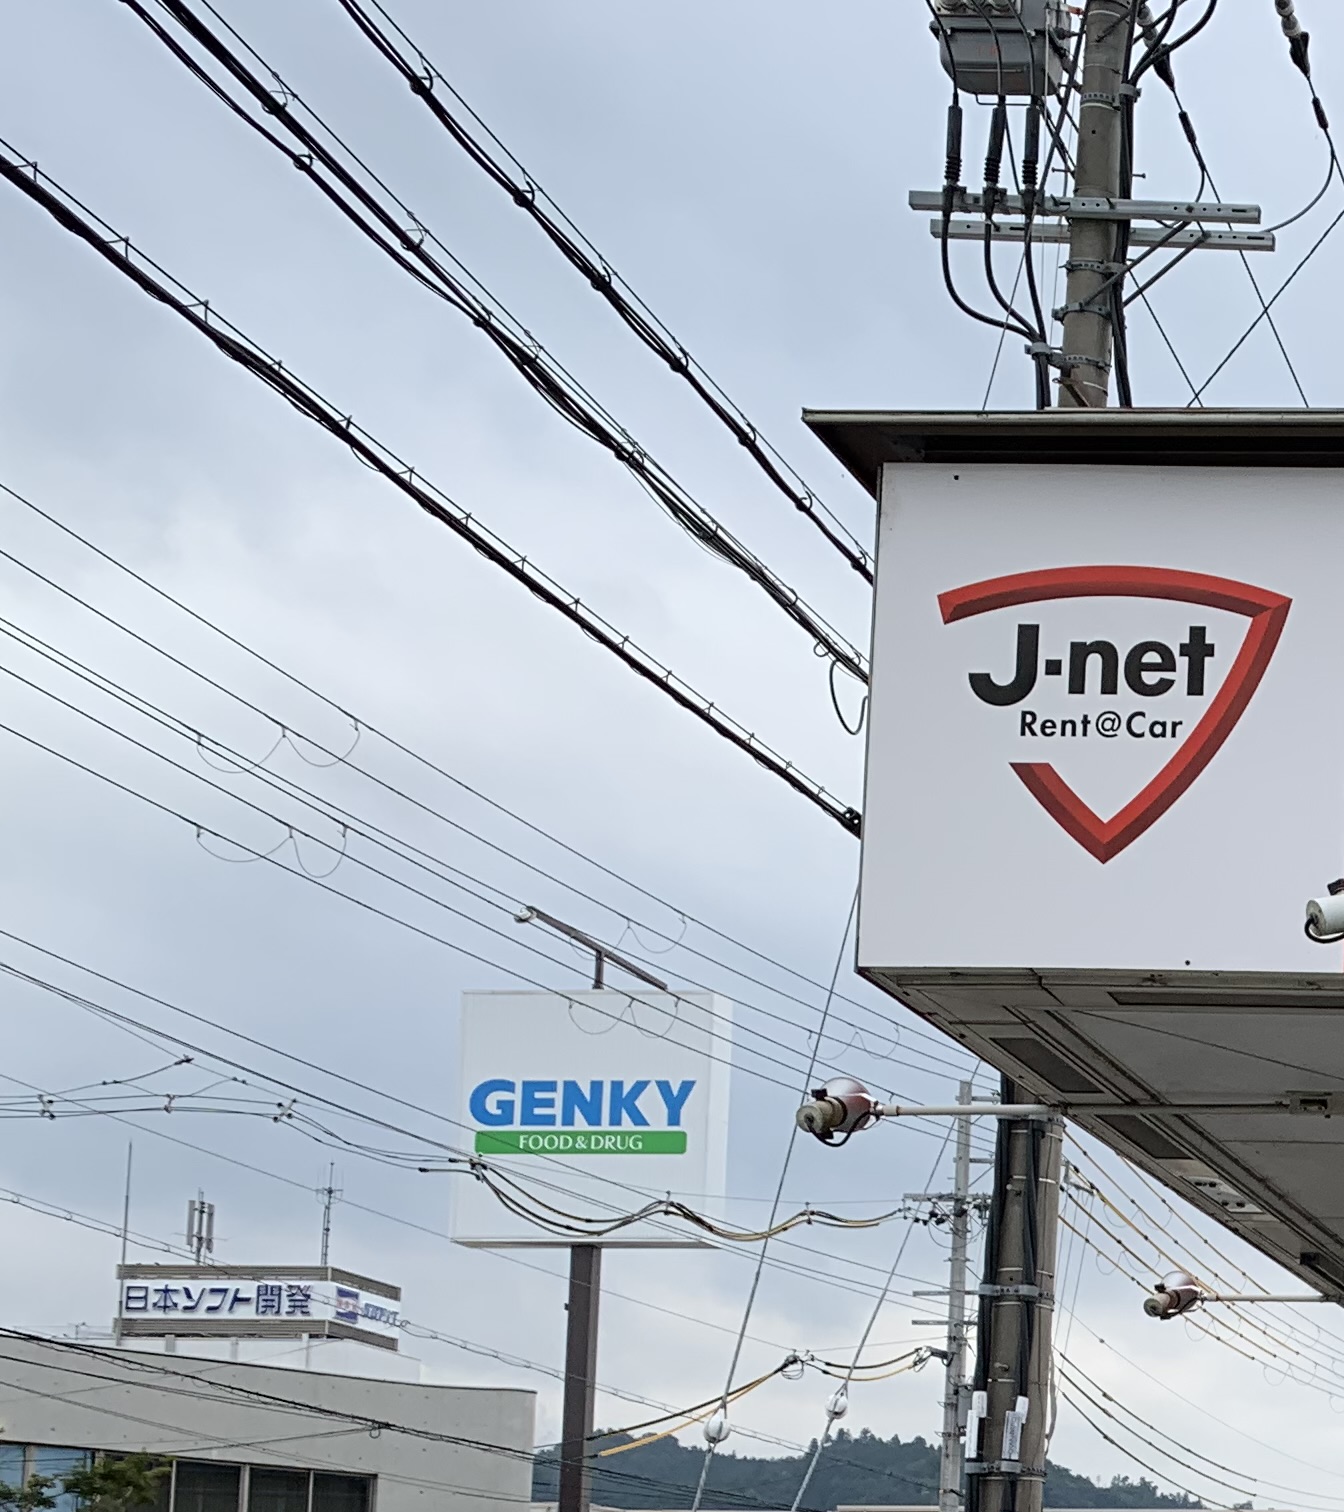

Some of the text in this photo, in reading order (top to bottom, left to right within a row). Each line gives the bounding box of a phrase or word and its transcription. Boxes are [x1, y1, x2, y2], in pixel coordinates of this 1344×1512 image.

[1019, 710, 1183, 739] Rent@Car
[469, 1078, 697, 1127] GENKY
[125, 1284, 311, 1316] 日本ソフト開発
